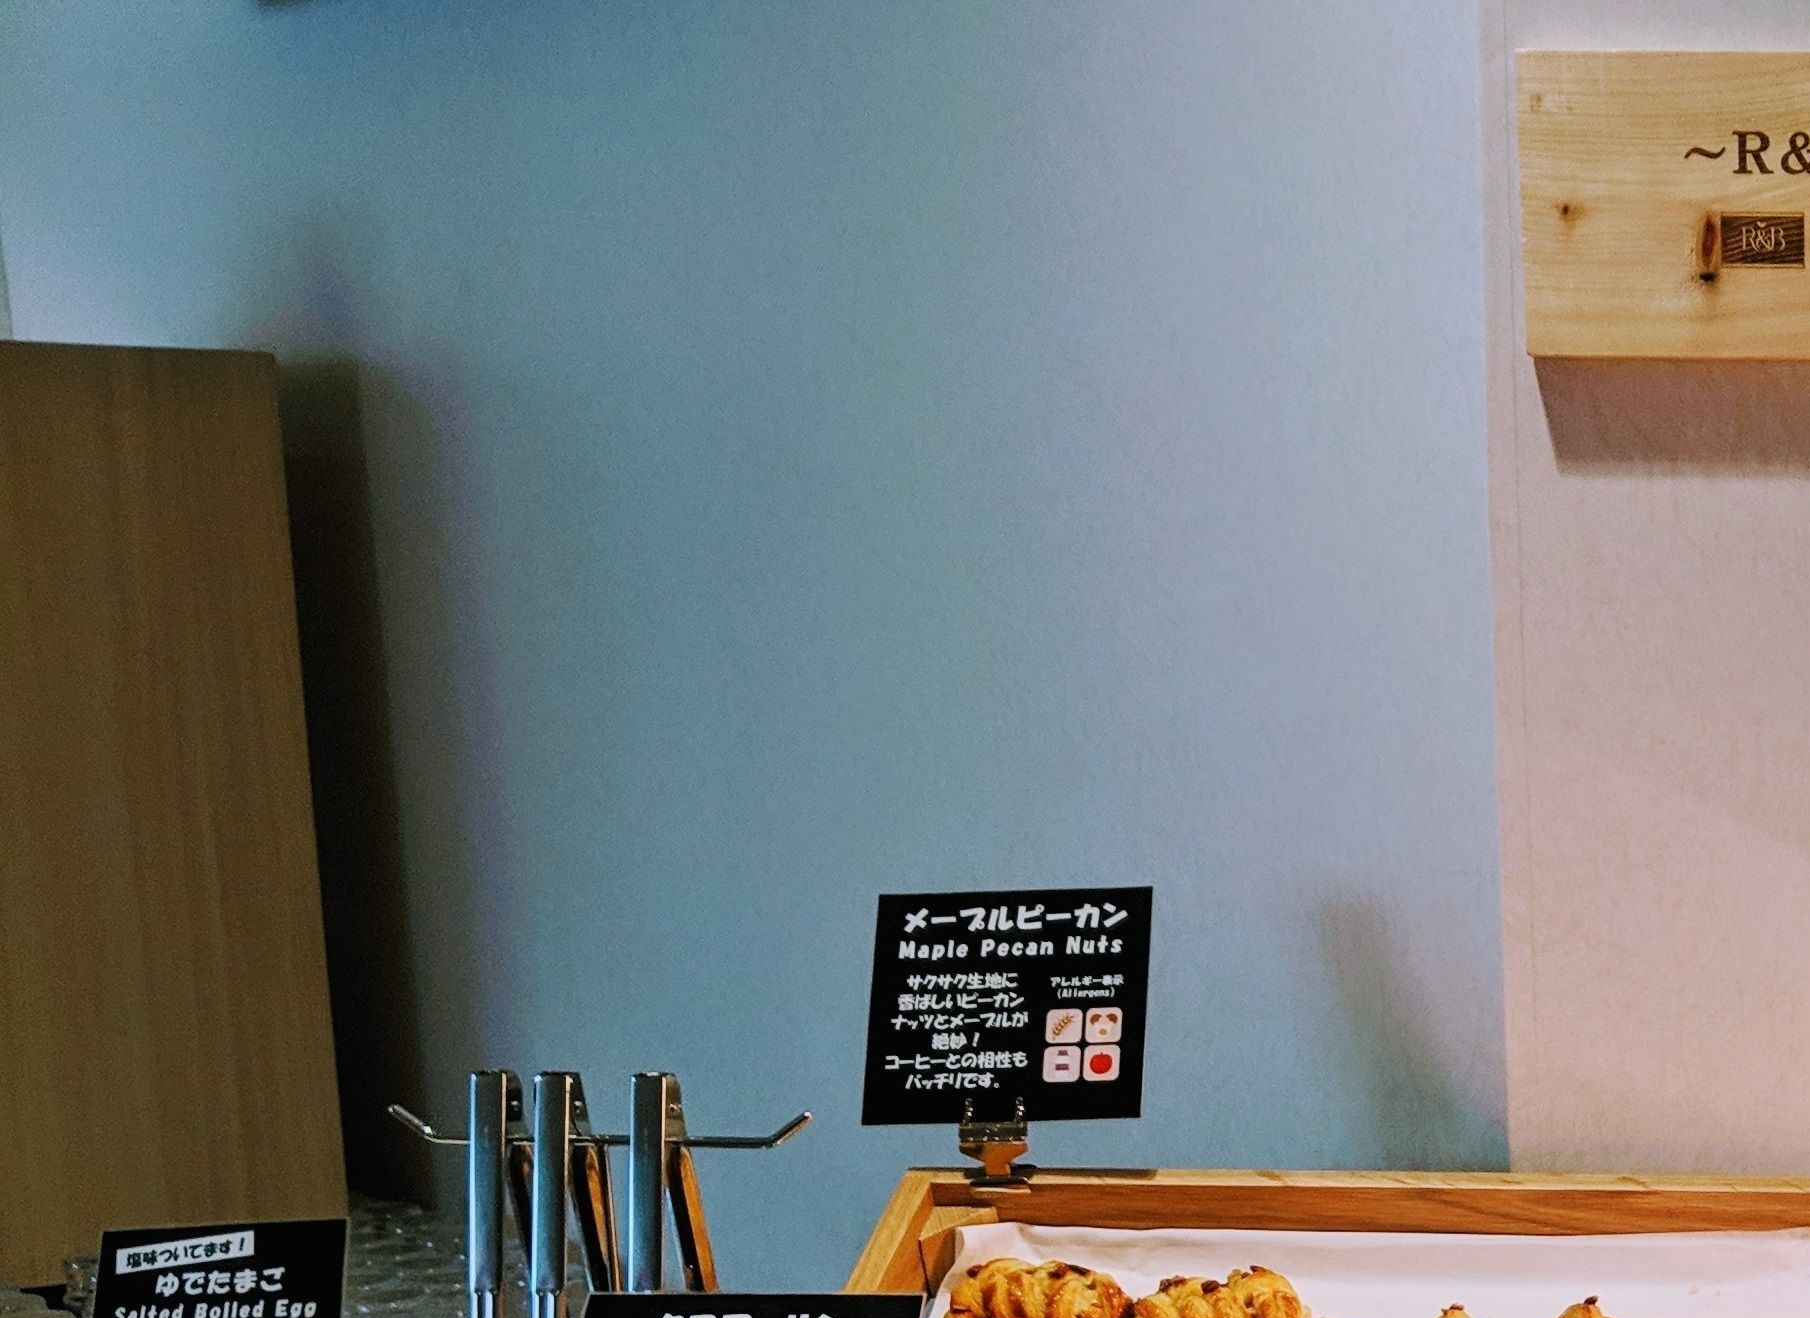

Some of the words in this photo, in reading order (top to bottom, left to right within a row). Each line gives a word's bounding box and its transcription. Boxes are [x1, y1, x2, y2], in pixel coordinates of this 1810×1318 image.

[1741, 224, 1786, 252] R&B
[904, 903, 1128, 933] メープルピーカン
[899, 940, 968, 960] Maple
[981, 939, 1053, 957] Pecan
[1066, 935, 1123, 954] Nuts
[907, 972, 1018, 990] サクサク生地に
[891, 1012, 1028, 1030] ナッツとメープルが
[885, 1051, 1028, 1069] コーヒーとの相性も
[905, 1072, 999, 1089] バッチリです。
[156, 1267, 285, 1296] ゆでたまご
[275, 1299, 316, 1318] Egg
